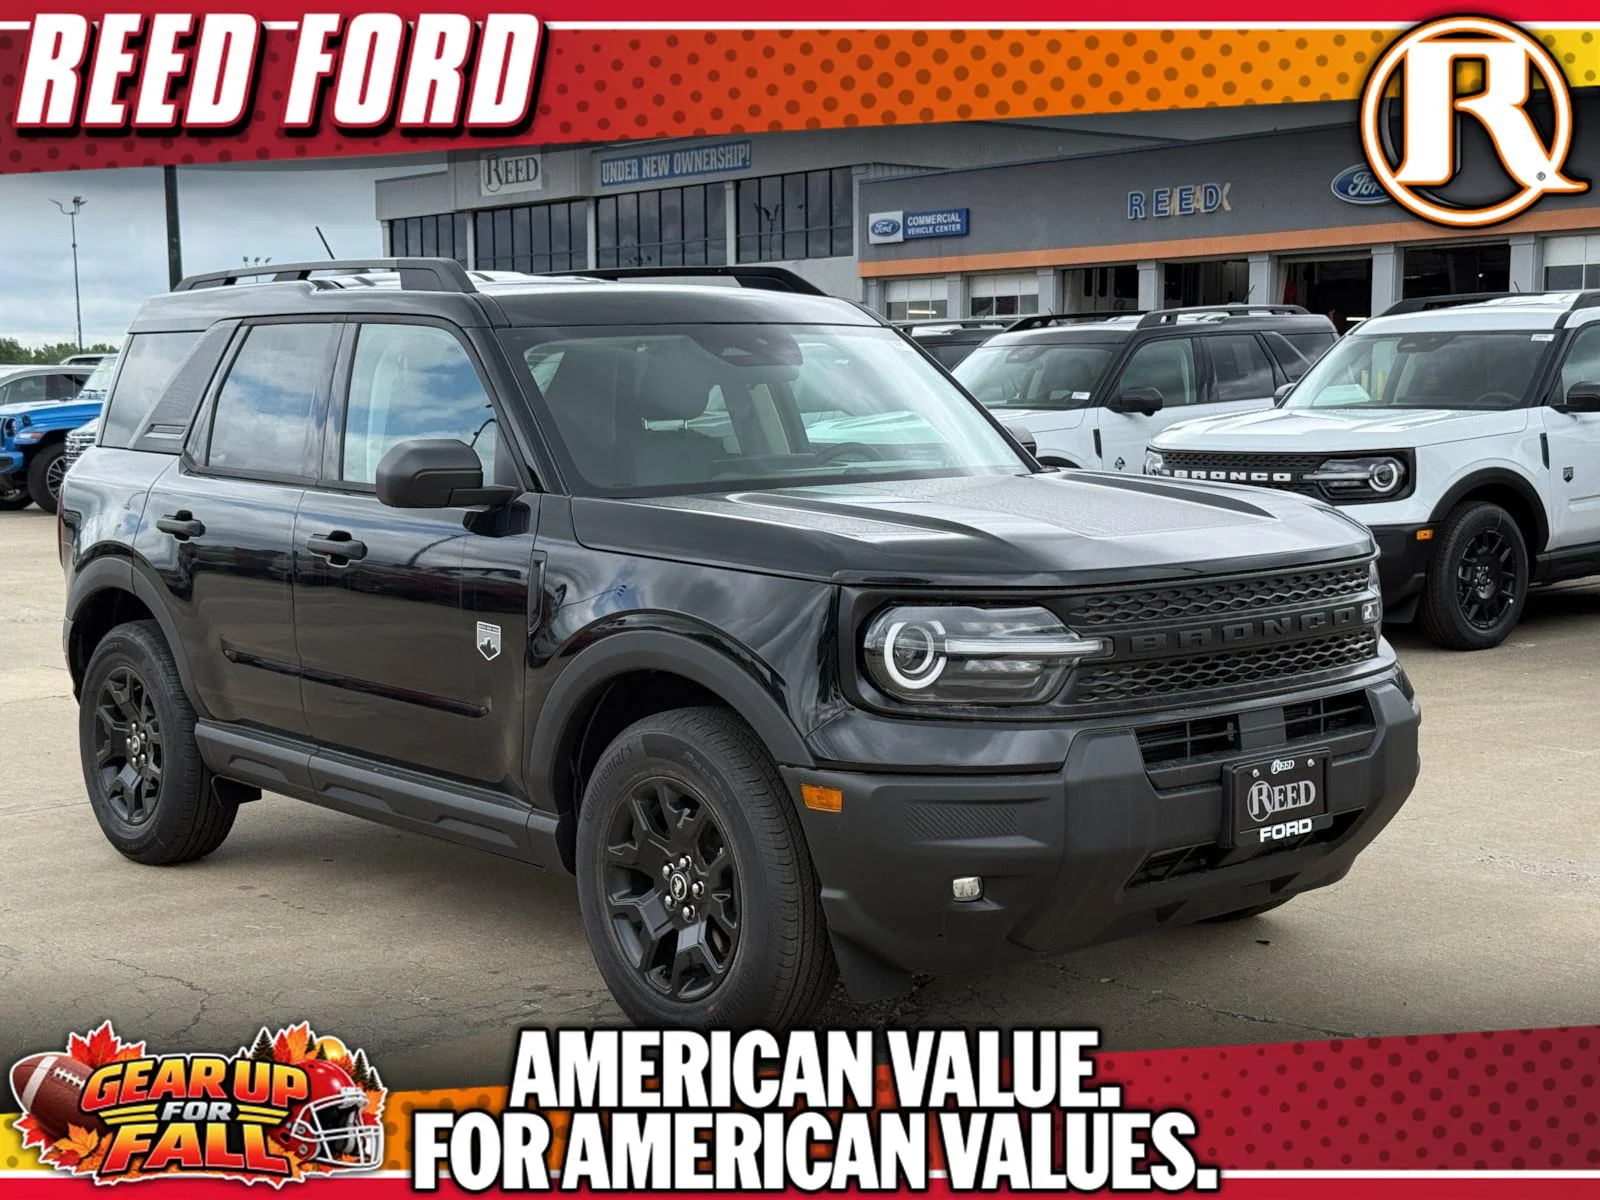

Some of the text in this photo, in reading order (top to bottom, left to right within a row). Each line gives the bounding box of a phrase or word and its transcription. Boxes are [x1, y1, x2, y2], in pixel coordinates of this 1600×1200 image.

[485, 154, 540, 191] REED
[602, 143, 751, 184] UNDER NEW OWNERSHIP!
[1127, 183, 1221, 220] REED
[874, 221, 893, 234] Ford
[907, 212, 961, 226] COMMERCIAL
[907, 223, 961, 235] VEHICLE CENTER
[1173, 469, 1292, 482] BRONCO
[1130, 606, 1356, 653] BRONCO
[1271, 759, 1295, 774] REED
[1247, 780, 1316, 822] REED
[1260, 818, 1312, 842] FORD
